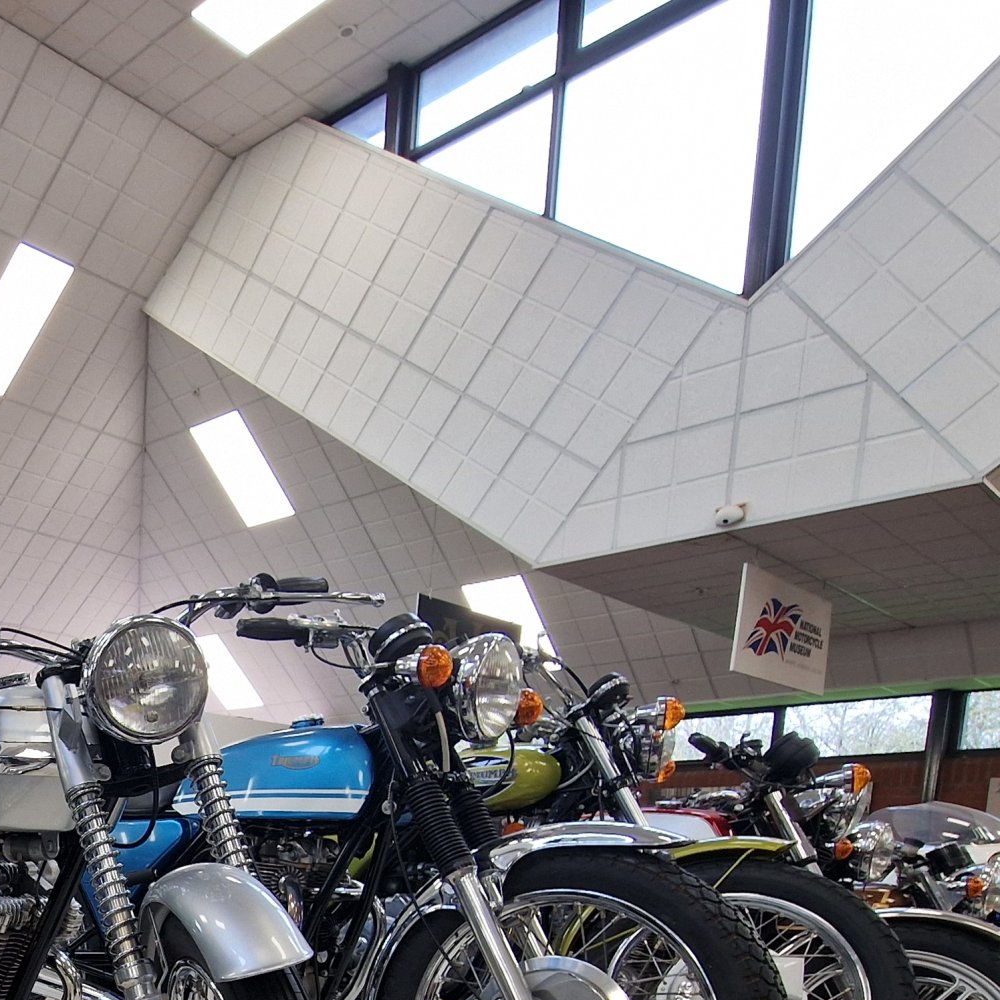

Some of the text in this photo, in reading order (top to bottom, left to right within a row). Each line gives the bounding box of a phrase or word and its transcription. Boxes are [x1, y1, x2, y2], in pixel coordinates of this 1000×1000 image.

[800, 619, 822, 637] NATIONAL
[794, 630, 824, 650] MOTORCYCLE
[789, 642, 811, 657] MUSEUM
